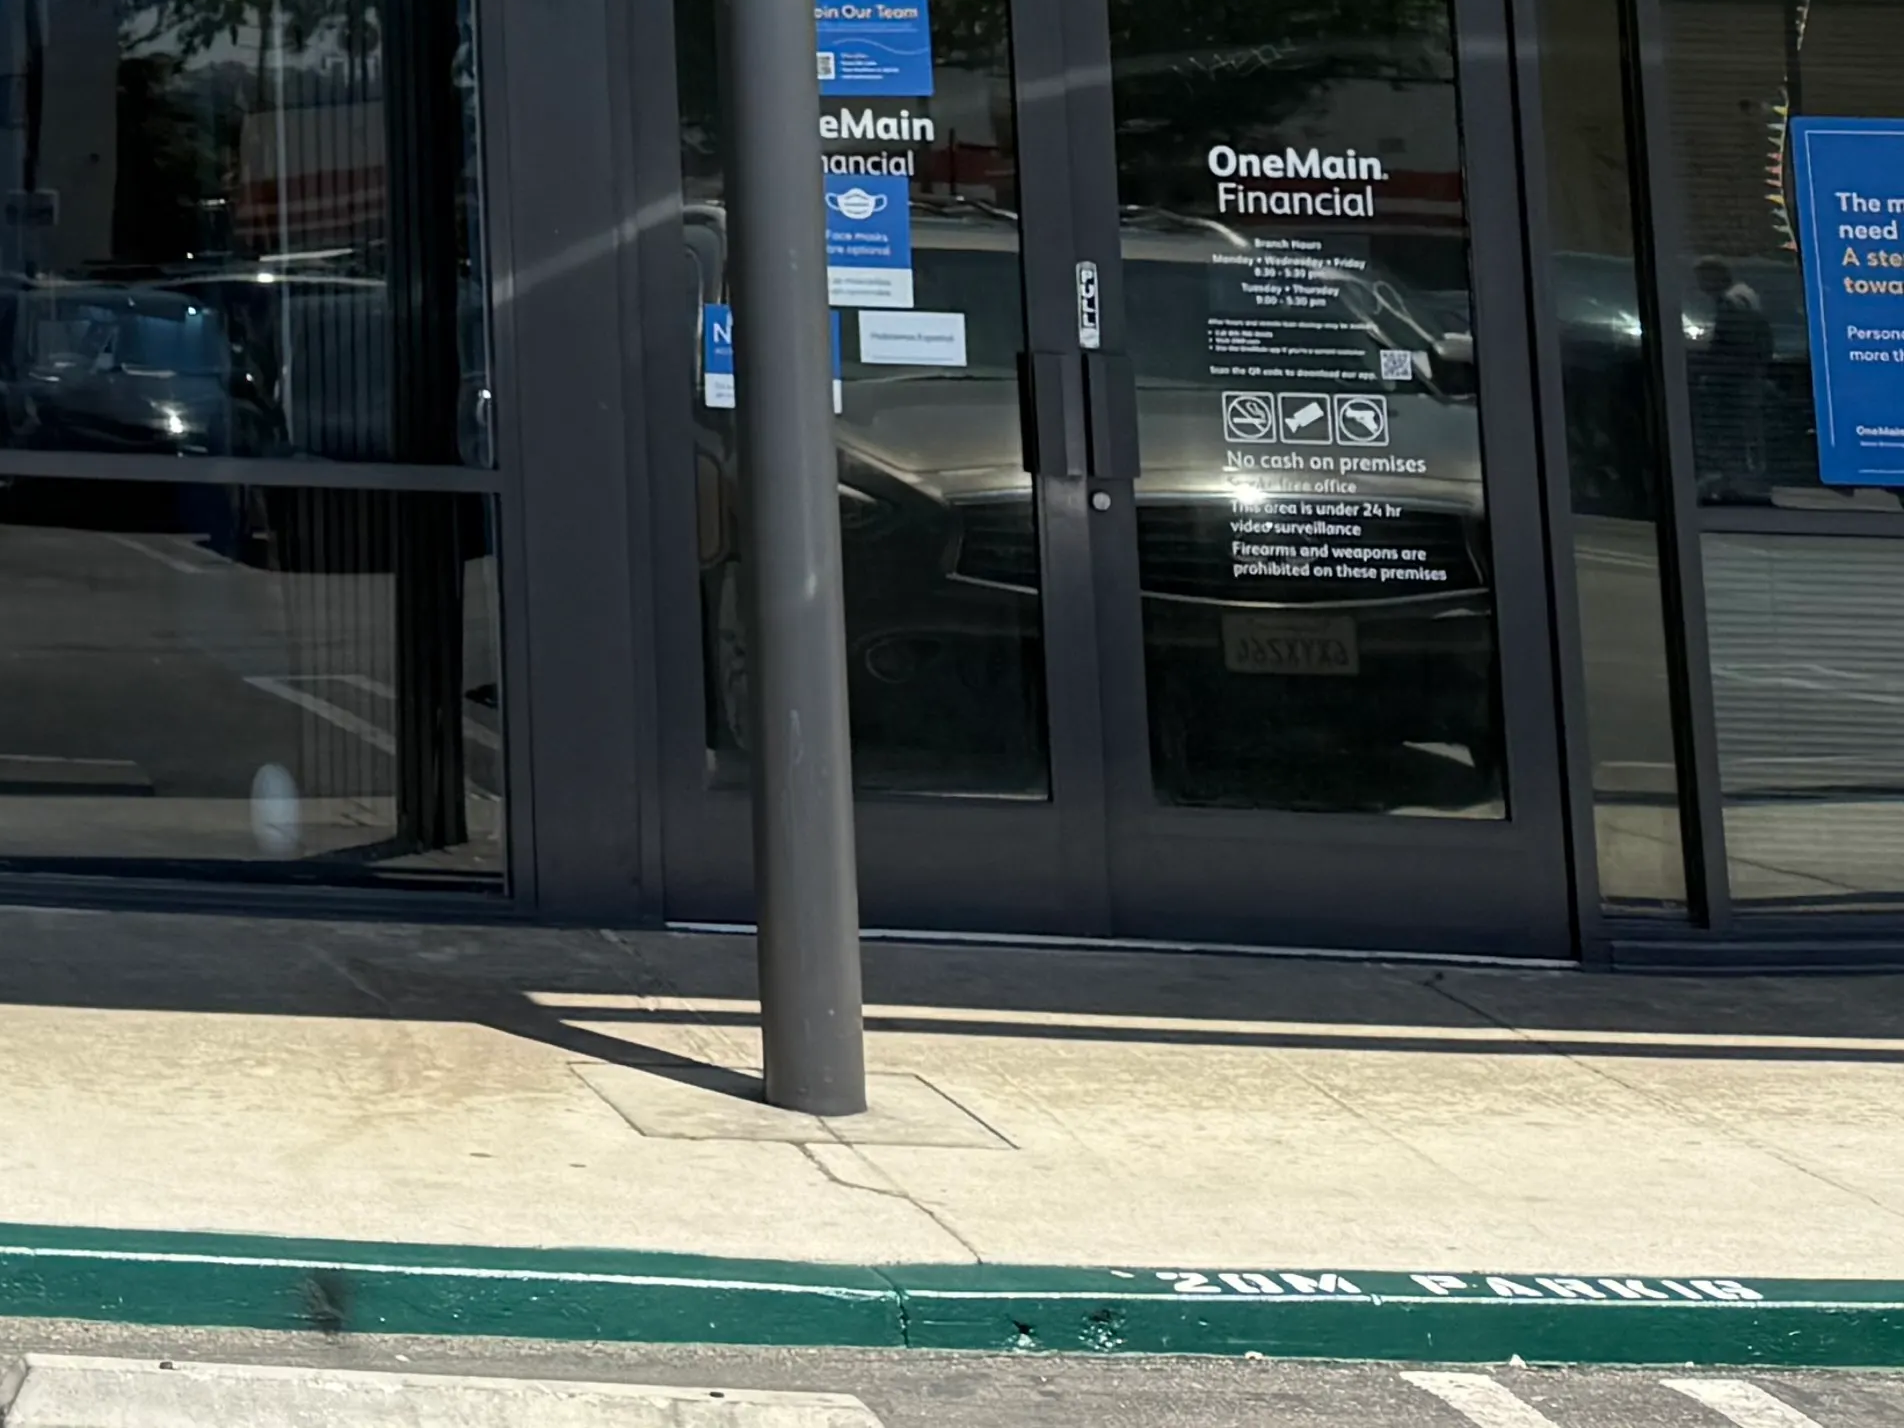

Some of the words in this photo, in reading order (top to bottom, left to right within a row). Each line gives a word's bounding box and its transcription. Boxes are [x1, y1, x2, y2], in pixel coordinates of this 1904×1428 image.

[814, 5, 838, 19] oin
[842, 5, 872, 19] Our
[876, 4, 918, 19] Team
[819, 108, 935, 141] eMain
[821, 149, 915, 176] ancial
[1208, 145, 1384, 180] OneMain
[1218, 182, 1374, 217] Financial
[1834, 192, 1881, 213] The
[1839, 219, 1898, 240] need
[1212, 255, 1254, 267] Monday
[1264, 256, 1323, 268] Wednesday
[1334, 258, 1366, 270] Friday
[1842, 247, 1860, 266] A
[1080, 270, 1096, 326] PULL
[1242, 283, 1282, 295] Tuesday
[1293, 284, 1340, 297] Thursday
[1849, 350, 1889, 362] more
[1226, 450, 1255, 469] No
[1260, 451, 1304, 470] cash
[1310, 455, 1334, 471] on
[1340, 455, 1427, 475] premises
[1314, 478, 1357, 493] office
[1264, 503, 1297, 515] area
[1301, 501, 1313, 515] is
[1316, 502, 1359, 517] under
[1363, 503, 1382, 517] 24
[1385, 503, 1402, 518] hr
[1230, 519, 1271, 535] video
[1274, 521, 1362, 537] surveillance
[1232, 541, 1296, 558] Firearms
[1300, 543, 1328, 559] and
[1331, 546, 1398, 562] weapons
[1401, 548, 1427, 561] are
[1233, 562, 1310, 579] prohibited
[1313, 565, 1333, 577] on
[1336, 564, 1377, 579] these
[1380, 565, 1447, 582] premises
